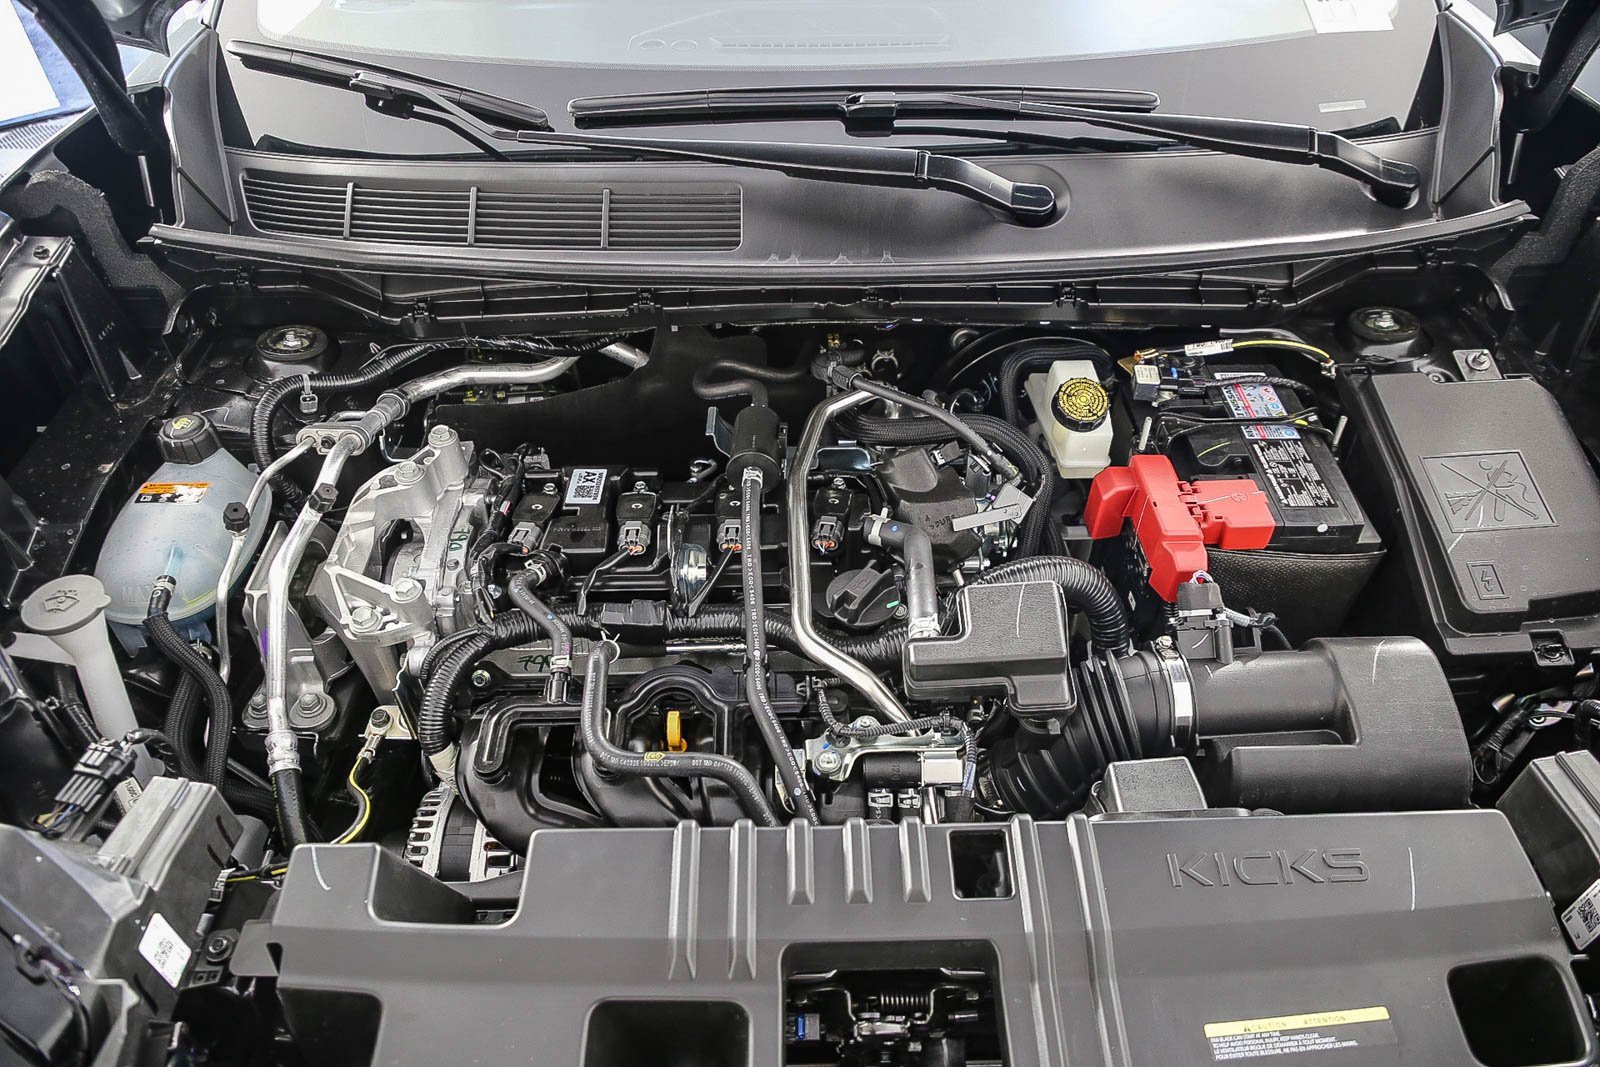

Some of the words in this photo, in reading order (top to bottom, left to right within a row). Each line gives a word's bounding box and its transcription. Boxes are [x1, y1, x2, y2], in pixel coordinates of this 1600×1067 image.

[583, 470, 596, 484] AX
[1166, 848, 1370, 888] KICKS
[1304, 1016, 1347, 1026] ATTENTION
